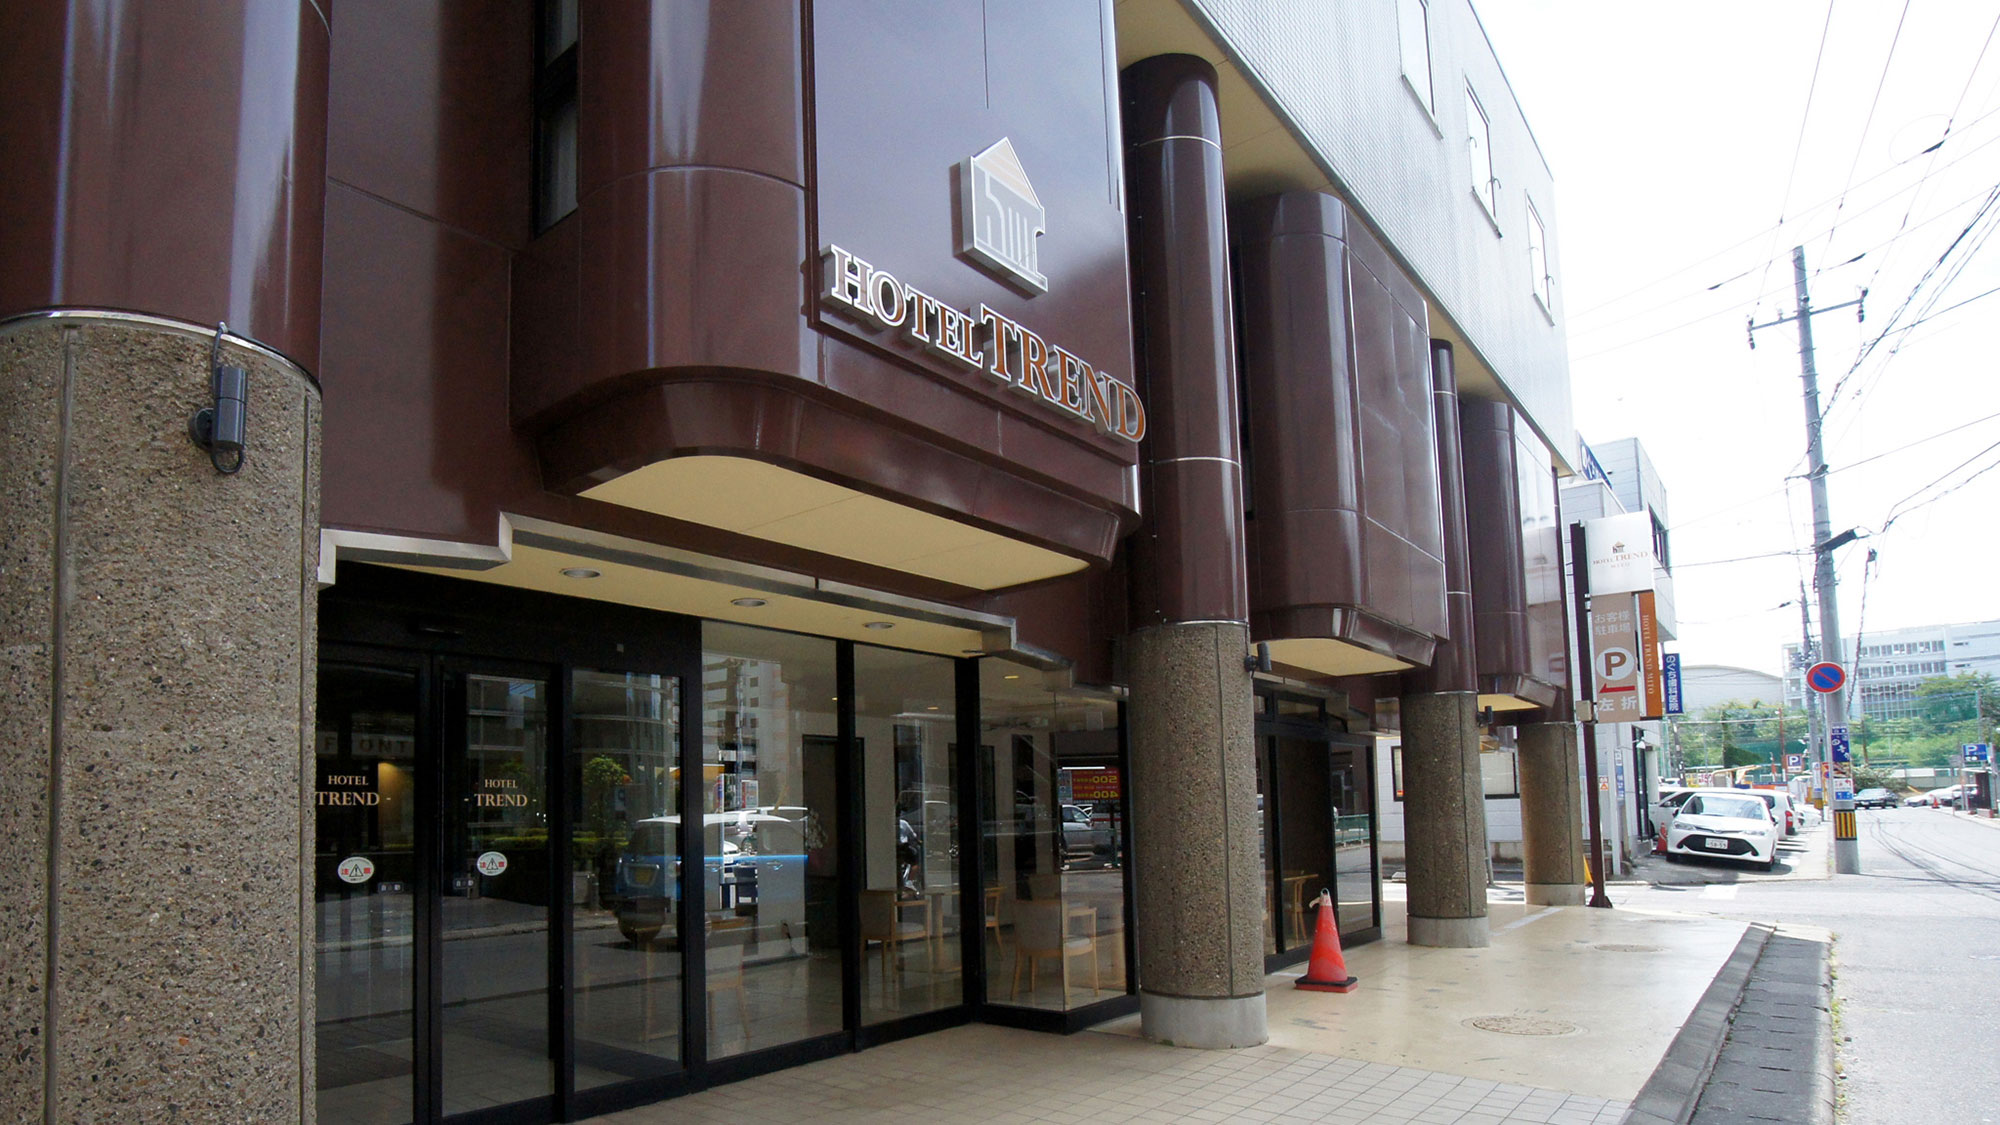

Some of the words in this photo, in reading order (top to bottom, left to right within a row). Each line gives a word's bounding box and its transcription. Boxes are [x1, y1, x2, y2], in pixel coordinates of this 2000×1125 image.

[830, 243, 984, 369] HOTEL
[980, 302, 1147, 443] TREND
[1614, 551, 1648, 562] TREND
[1604, 651, 1627, 677] P
[1646, 672, 1654, 695] MITO
[1789, 755, 1799, 766] P
[327, 775, 369, 786] HOTEL
[484, 779, 518, 789] HOTEL
[315, 791, 380, 806] TREND
[474, 793, 528, 807] TREND
